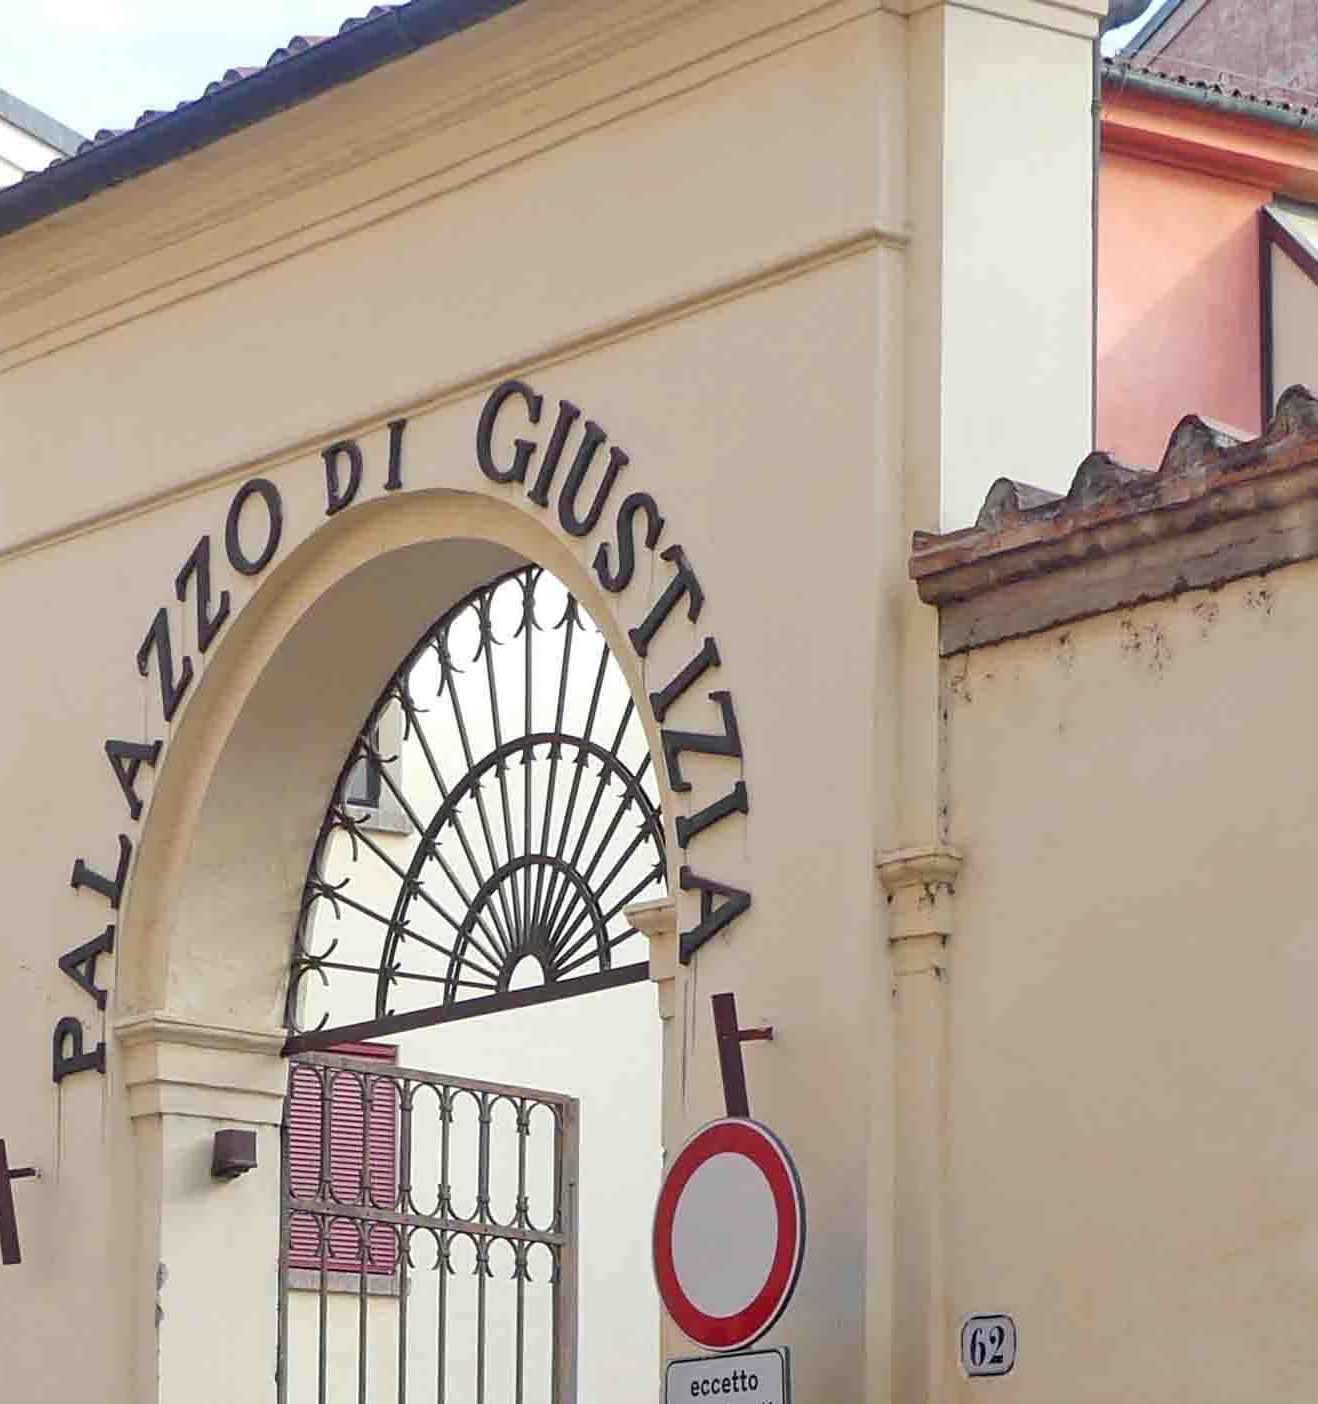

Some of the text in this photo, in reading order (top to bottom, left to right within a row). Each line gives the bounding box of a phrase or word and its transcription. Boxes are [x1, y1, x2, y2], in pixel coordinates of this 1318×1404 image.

[53, 380, 751, 1083] PALAZZO DI GIUSTIZIA
[970, 1325, 1005, 1367] 62
[690, 1370, 759, 1397] eccetto
